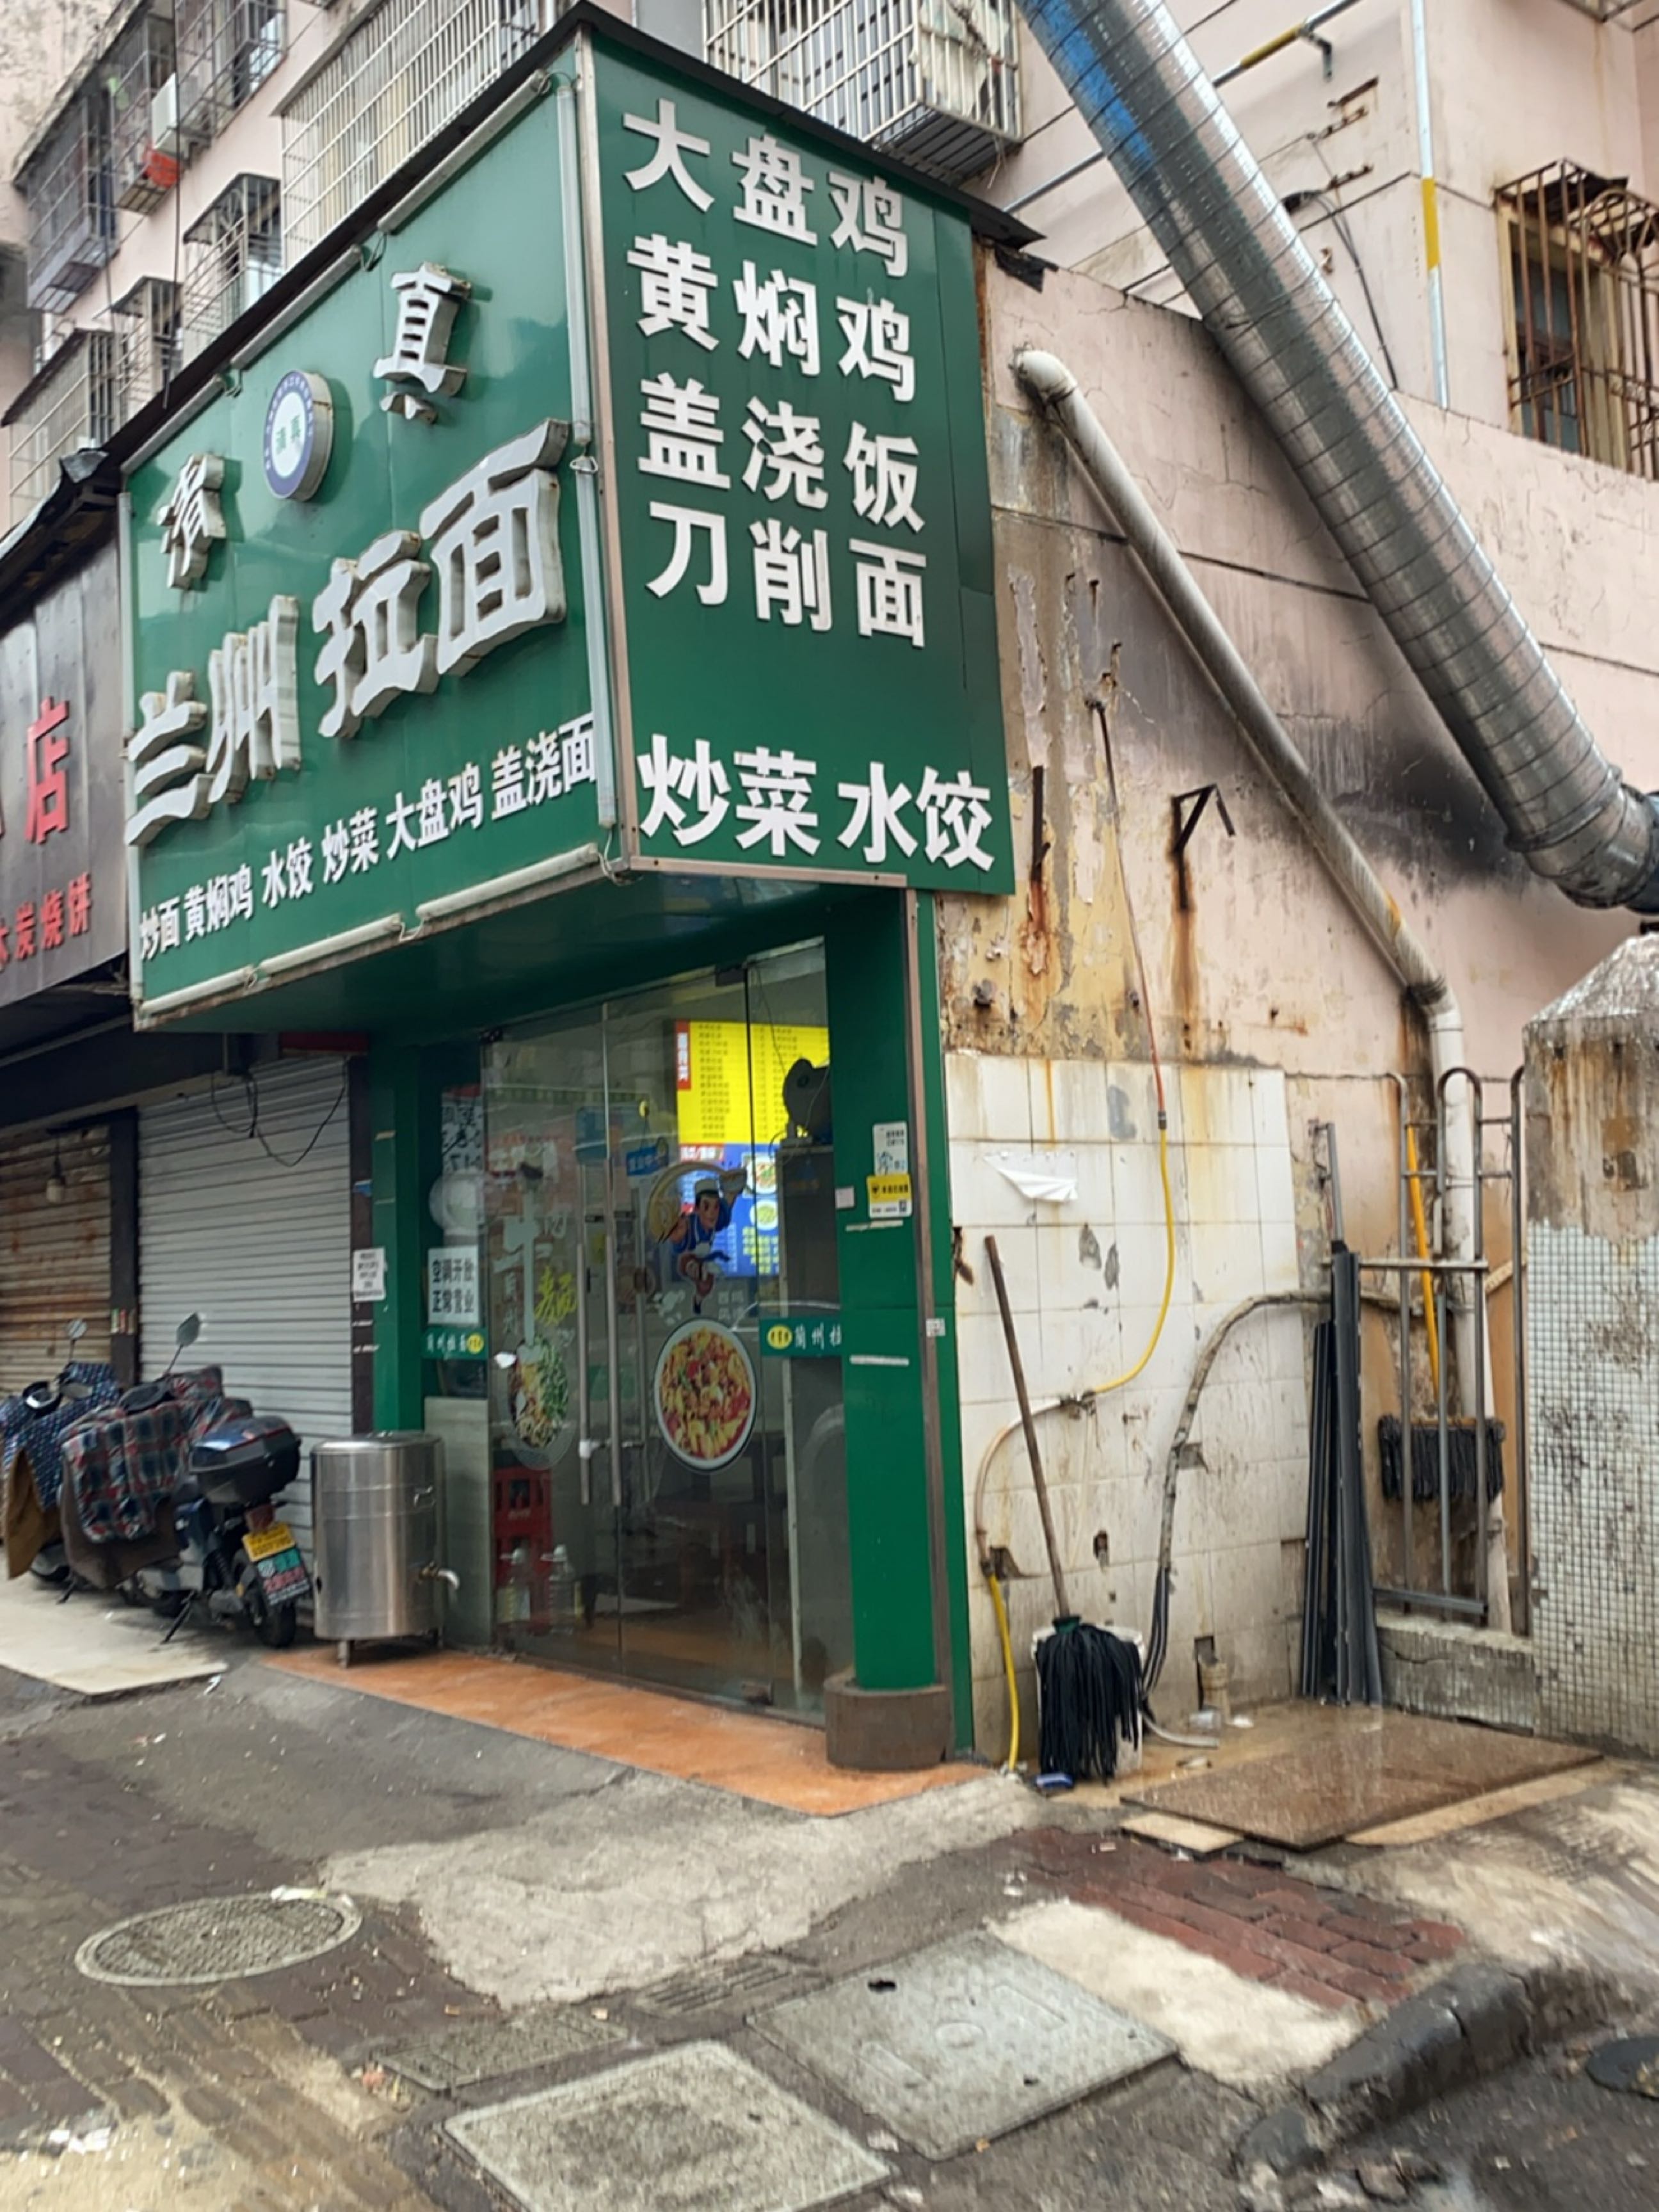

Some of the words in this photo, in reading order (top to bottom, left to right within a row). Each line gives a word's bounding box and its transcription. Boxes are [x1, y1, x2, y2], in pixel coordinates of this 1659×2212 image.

[623, 98, 908, 277] 大盘鸡
[627, 234, 915, 401] 黄焖鸡
[638, 373, 926, 533] 盖浇饭
[125, 419, 568, 846] 兰州拉面
[646, 501, 927, 649] 刀削面
[25, 695, 70, 845] 店
[140, 897, 180, 959] 炒面
[184, 863, 254, 942] 黄焖鸡
[262, 836, 314, 908] 水饺
[321, 806, 380, 883] 炒菜
[386, 761, 483, 860] 大盘鸡
[491, 712, 597, 821] 盖浇面
[637, 733, 821, 857] 炒菜
[837, 761, 995, 872] 水饺
